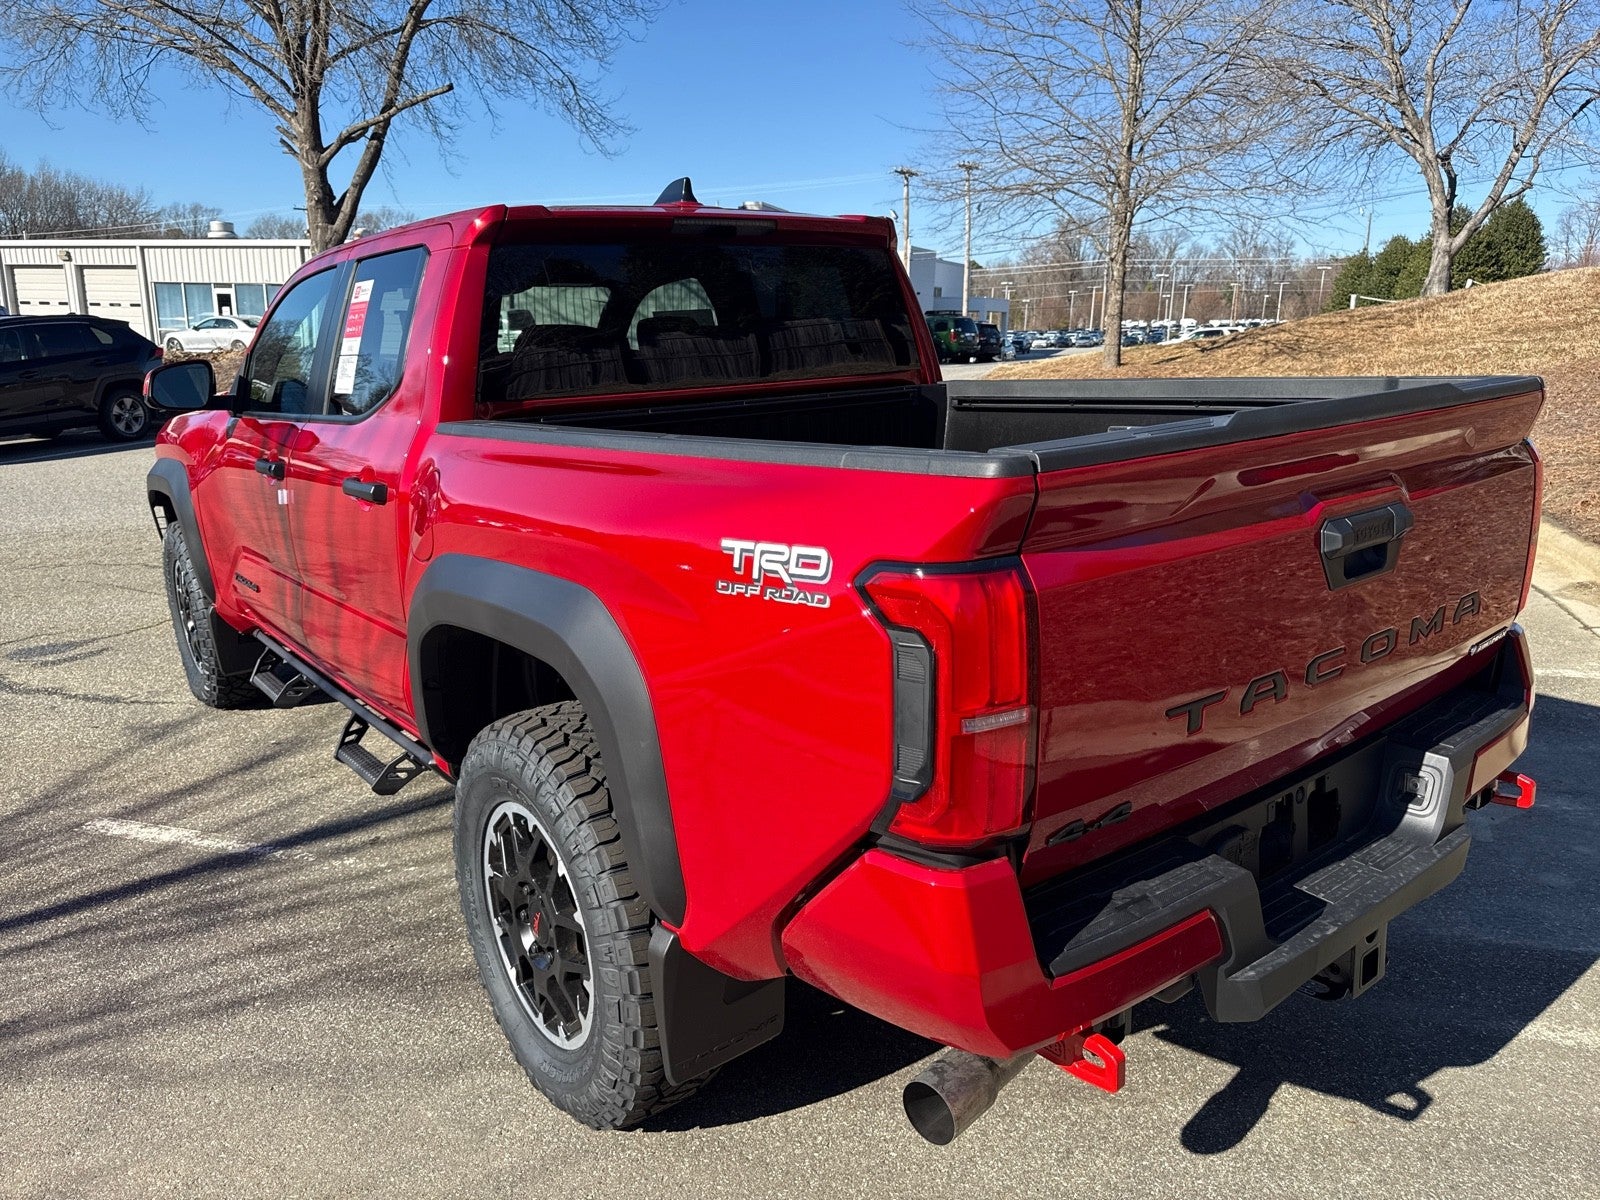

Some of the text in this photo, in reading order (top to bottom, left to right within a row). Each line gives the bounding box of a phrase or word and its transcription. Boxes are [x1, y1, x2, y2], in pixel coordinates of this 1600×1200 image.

[720, 537, 833, 589] TRD
[716, 580, 831, 609] OFF ROAD
[1165, 591, 1481, 736] TACOMA
